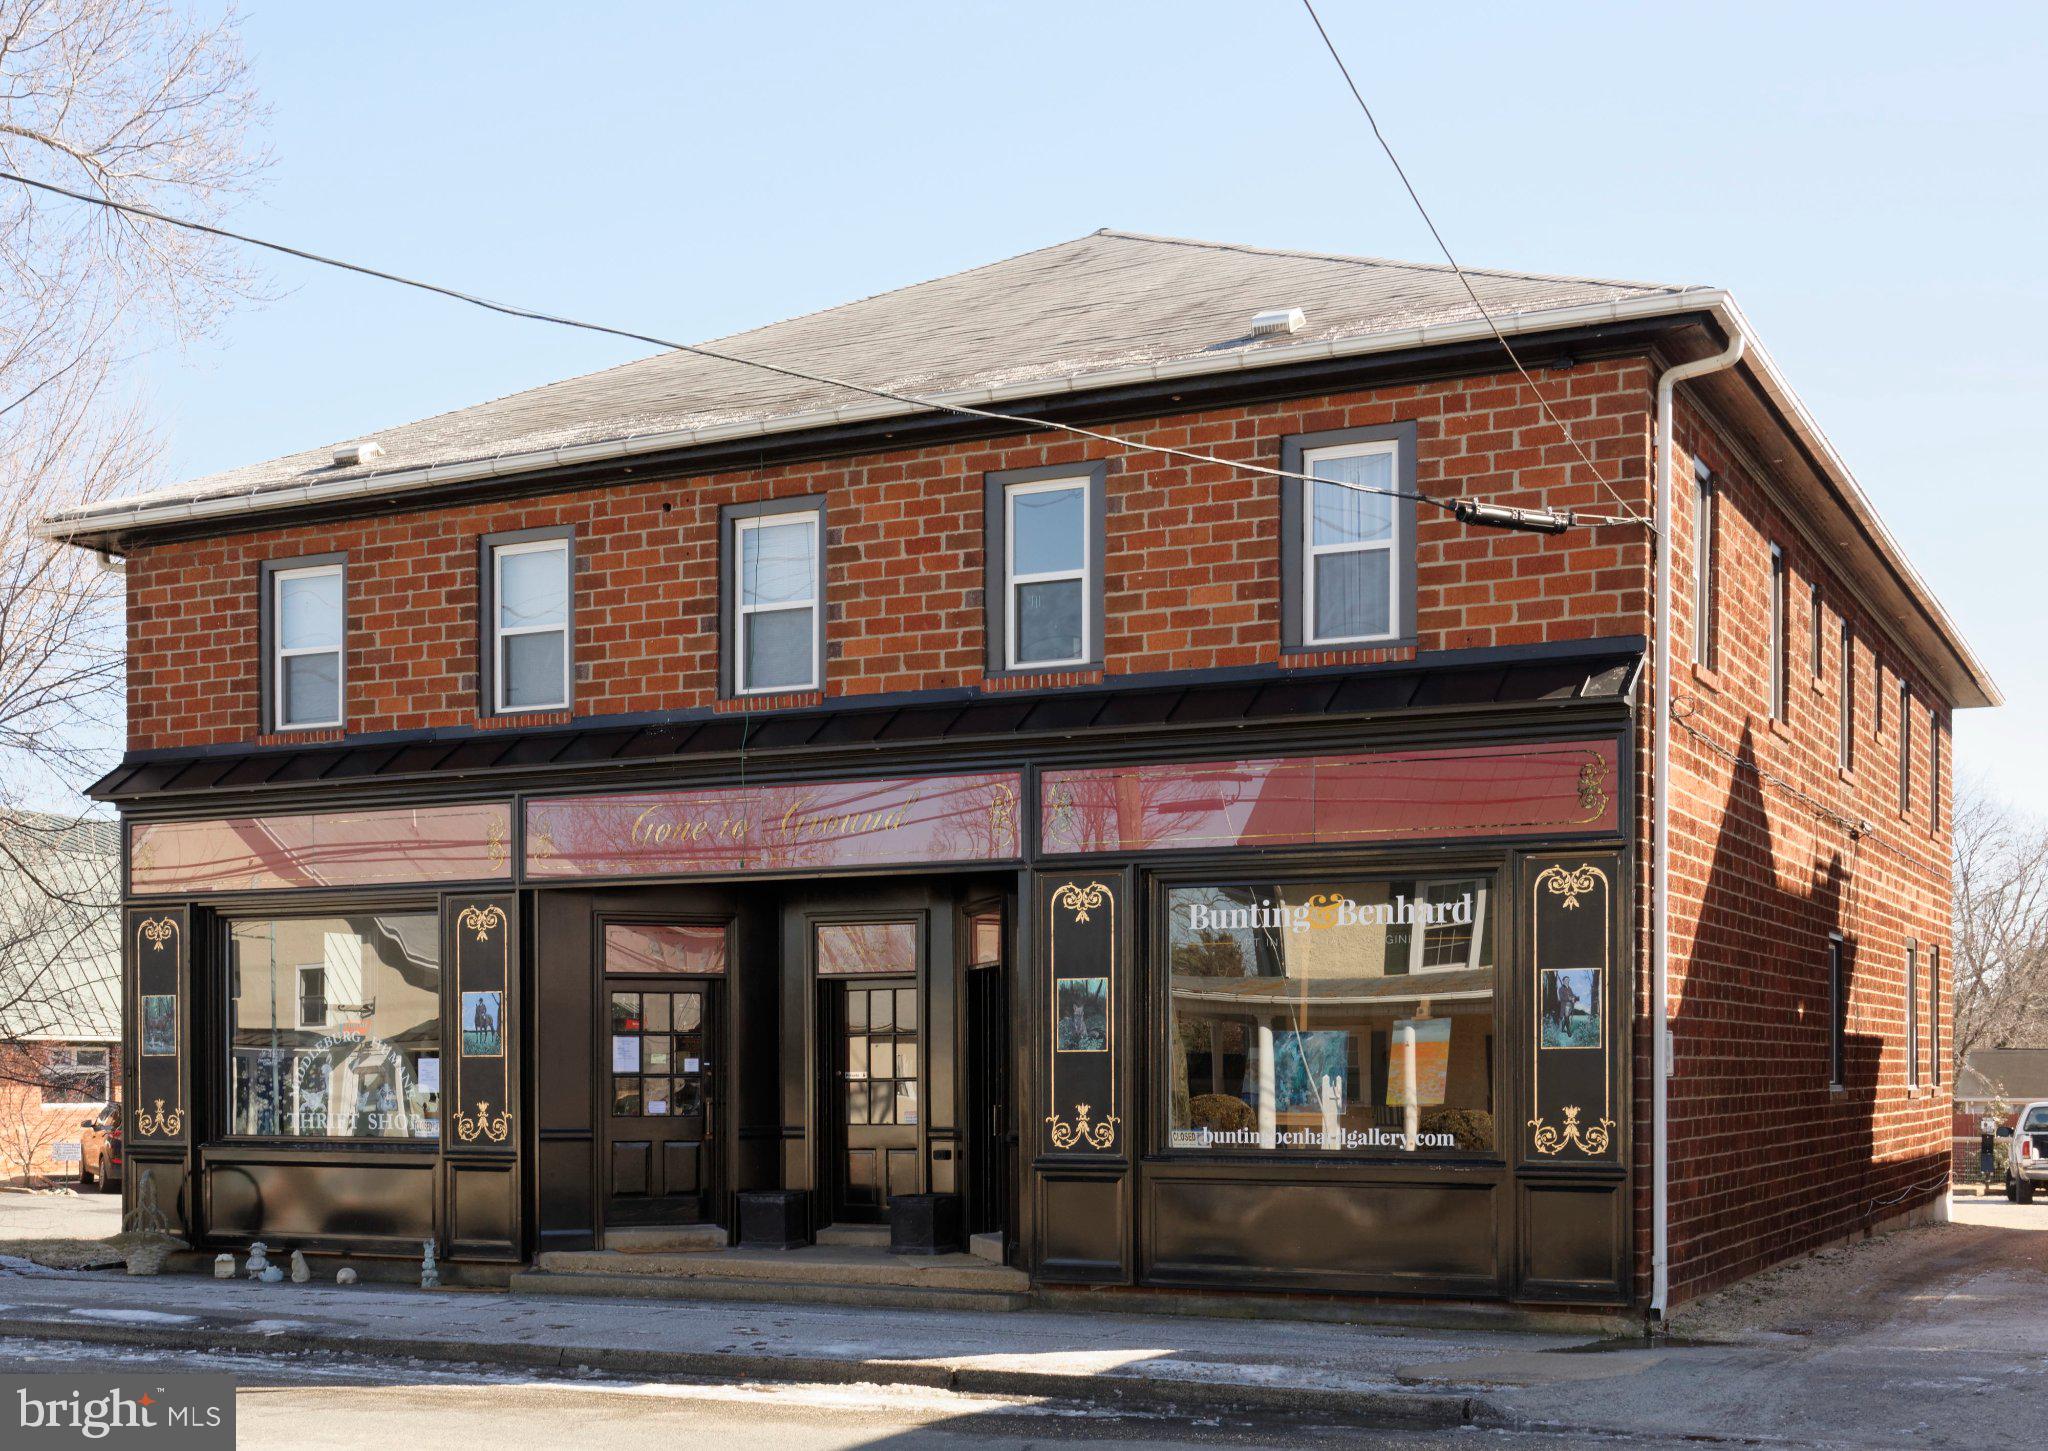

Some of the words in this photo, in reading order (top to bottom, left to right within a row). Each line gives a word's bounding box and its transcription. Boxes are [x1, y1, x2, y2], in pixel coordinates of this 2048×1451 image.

[632, 804, 709, 854] Gone
[719, 814, 751, 839] to
[1188, 900, 1312, 933] Bunting
[1334, 893, 1473, 928] Benhard
[289, 1031, 361, 1096] DDLEBURG
[286, 1112, 360, 1130] THRIFT
[1172, 1131, 1197, 1142] CLOSED
[1202, 1126, 1455, 1149] buntinenhagallerycom
